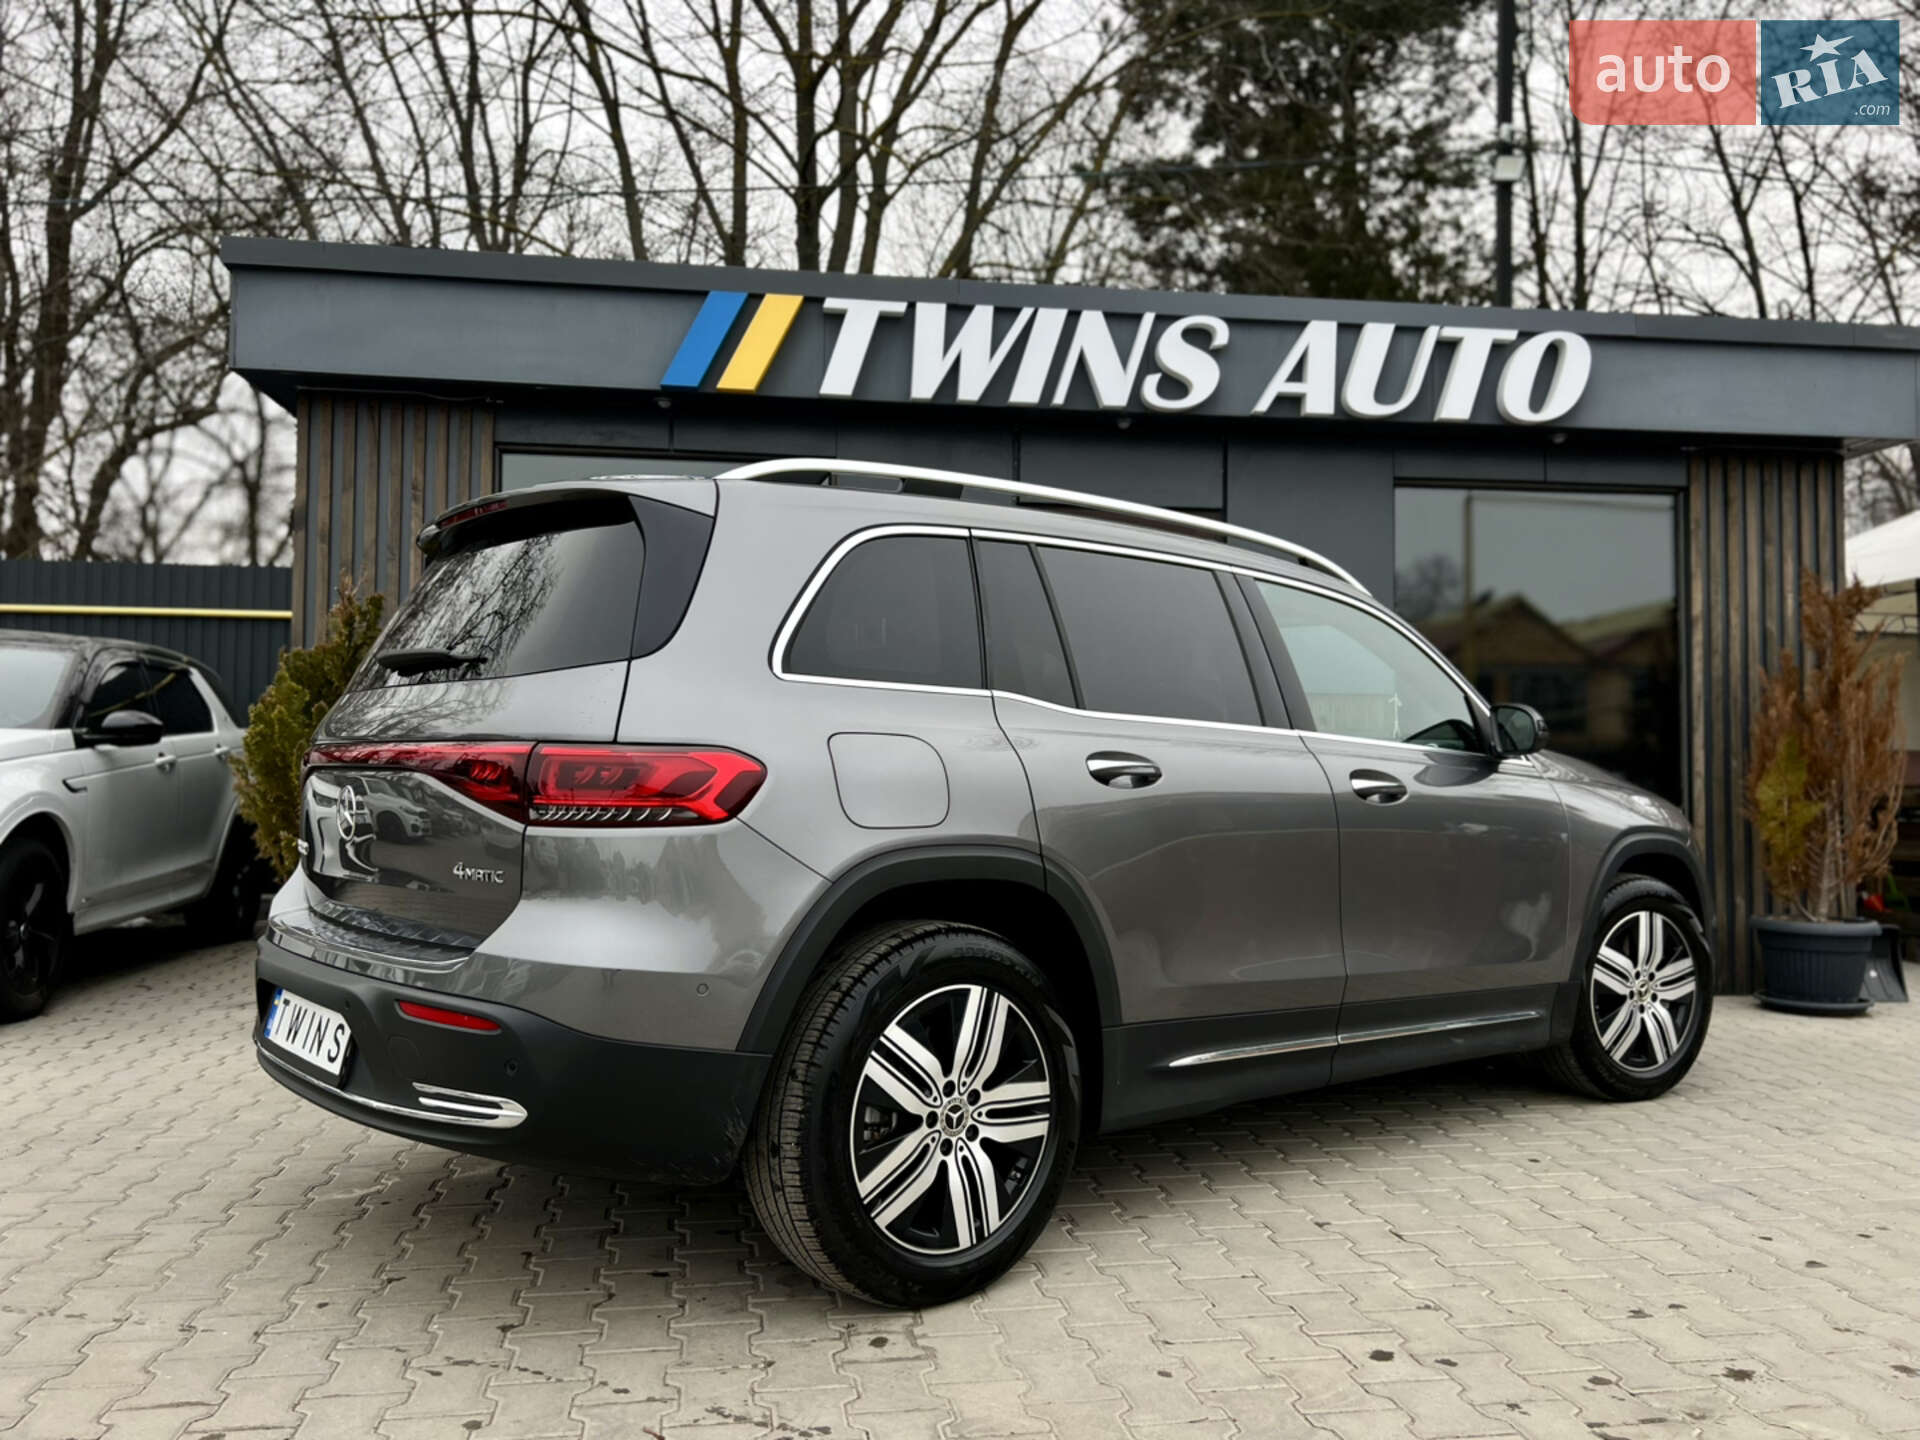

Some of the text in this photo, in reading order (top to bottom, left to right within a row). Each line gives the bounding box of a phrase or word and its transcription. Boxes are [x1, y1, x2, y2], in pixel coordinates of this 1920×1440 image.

[819, 297, 1592, 425] TWINS AUTO
[453, 862, 504, 884] 4MATIC
[275, 998, 345, 1064] TWINS
